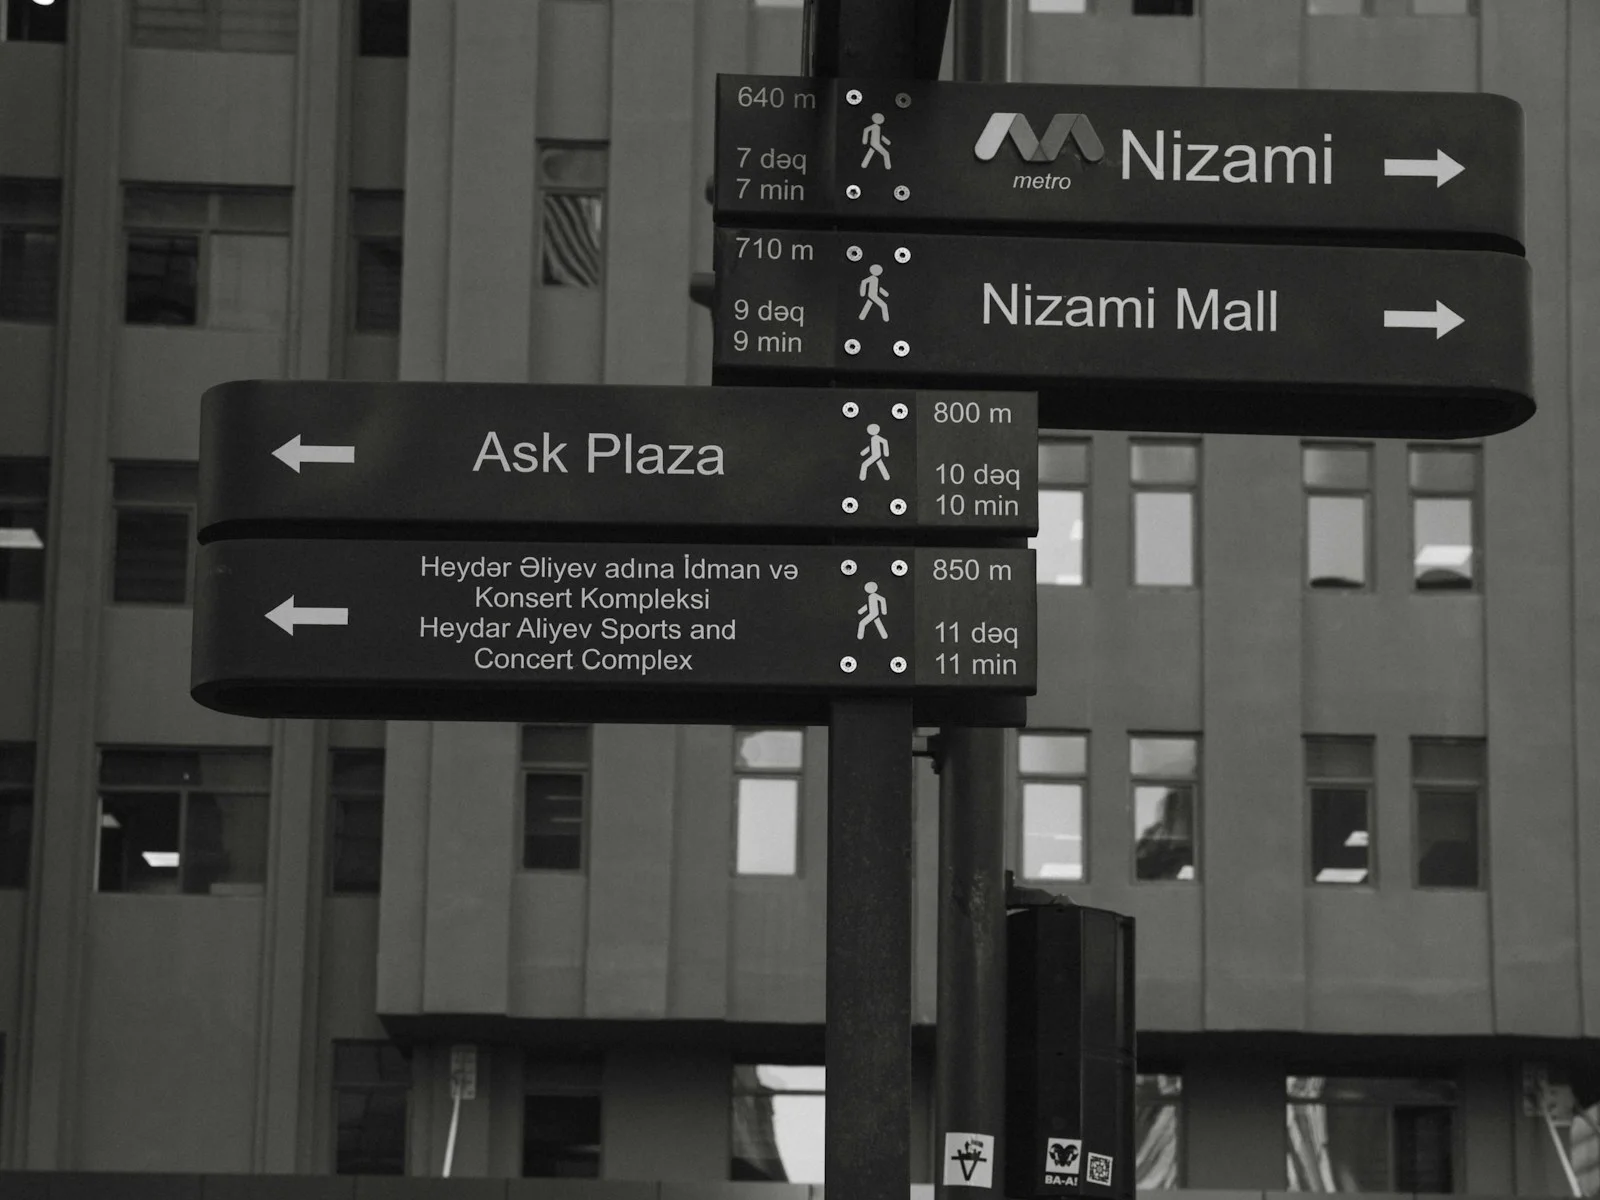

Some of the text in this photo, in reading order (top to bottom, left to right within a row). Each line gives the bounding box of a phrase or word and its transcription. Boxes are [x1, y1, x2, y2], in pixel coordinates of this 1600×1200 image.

[738, 87, 815, 108] 640 m
[737, 148, 806, 175] 7 dəq
[1123, 129, 1331, 184] Nizami
[737, 178, 803, 200] 7 min
[1013, 174, 1071, 189] metro
[736, 237, 813, 260] 710 m
[735, 299, 803, 327] 9 dəq
[984, 283, 1277, 331] Nizami Mall
[734, 330, 801, 352] 9 min
[934, 402, 1011, 423] 800 m
[473, 432, 724, 475] Ask Plaza
[936, 464, 1019, 490] 10 dəq
[937, 495, 1018, 515] 10 min
[422, 554, 798, 583] Heydər Əliyev adına İdman və
[933, 559, 1011, 580] 850 m
[476, 587, 709, 614] Konsert Kompleksi
[421, 617, 735, 644] Heydar Aliyev Sports and
[936, 622, 1017, 649] 11 dəq
[475, 648, 692, 675] Concert Complex
[936, 653, 1016, 674] 11 min
